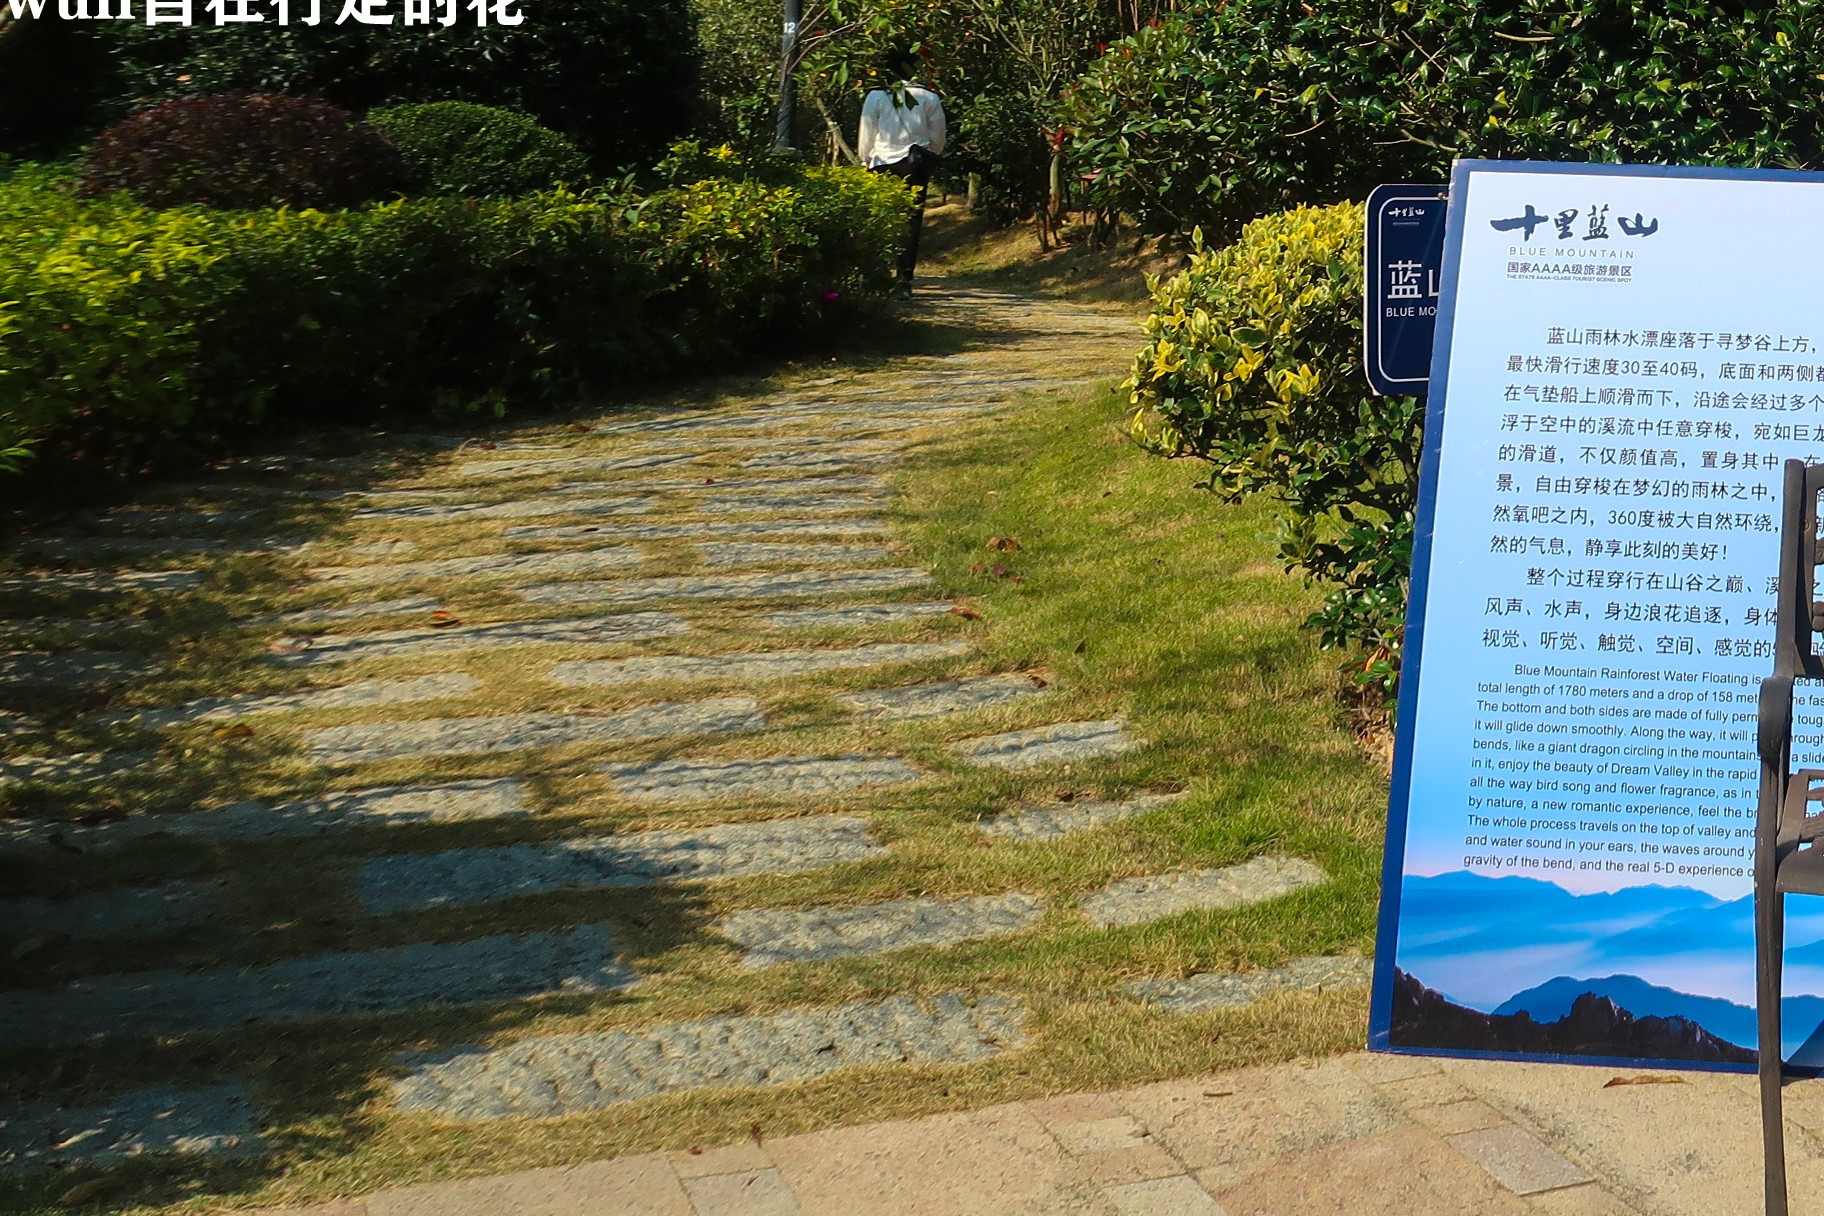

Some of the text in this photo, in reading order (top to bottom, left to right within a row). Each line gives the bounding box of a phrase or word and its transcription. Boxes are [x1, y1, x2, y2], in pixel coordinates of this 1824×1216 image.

[1490, 204, 1658, 242] 十里蓝山
[1509, 247, 1634, 259] BLUE MOUNTAIN
[1507, 261, 1632, 277] 国家AAAA级旅游景区
[1386, 307, 1415, 317] BLUE
[1514, 664, 1748, 687] Blue Mountain Rainforest Water Floating
[1478, 681, 1502, 693] total
[1505, 682, 1540, 697] length
[1559, 684, 1586, 697] 1780
[1590, 686, 1629, 698] meters
[1668, 689, 1694, 704] drop
[1712, 690, 1732, 703] 158
[1477, 700, 1498, 712] The
[1502, 701, 1542, 714] bottom
[1544, 703, 1566, 715] and
[1570, 704, 1595, 716] both
[1599, 705, 1629, 718] sides
[1632, 709, 1651, 718] are
[1655, 707, 1687, 720] made
[1706, 709, 1729, 724] fully
[1484, 719, 1748, 743] will glide down smoothly. Along way, will
[1473, 737, 1511, 752] bends,
[1515, 739, 1534, 751] like
[1548, 741, 1576, 756] giant
[1579, 742, 1620, 758] dragon
[1624, 744, 1664, 759] circling
[1498, 760, 1756, 782] enjoy beauty Dream Valley rapid
[1470, 776, 1718, 801] all way bird song flower fragrance,
[1486, 796, 1720, 819] nature, new romantic experience, feel
[1468, 815, 1731, 840] The whole process travels top valley
[1465, 834, 1744, 858] and water sound your ears, the waves around
[1464, 854, 1743, 879] gravity bend, real 5-D experience
